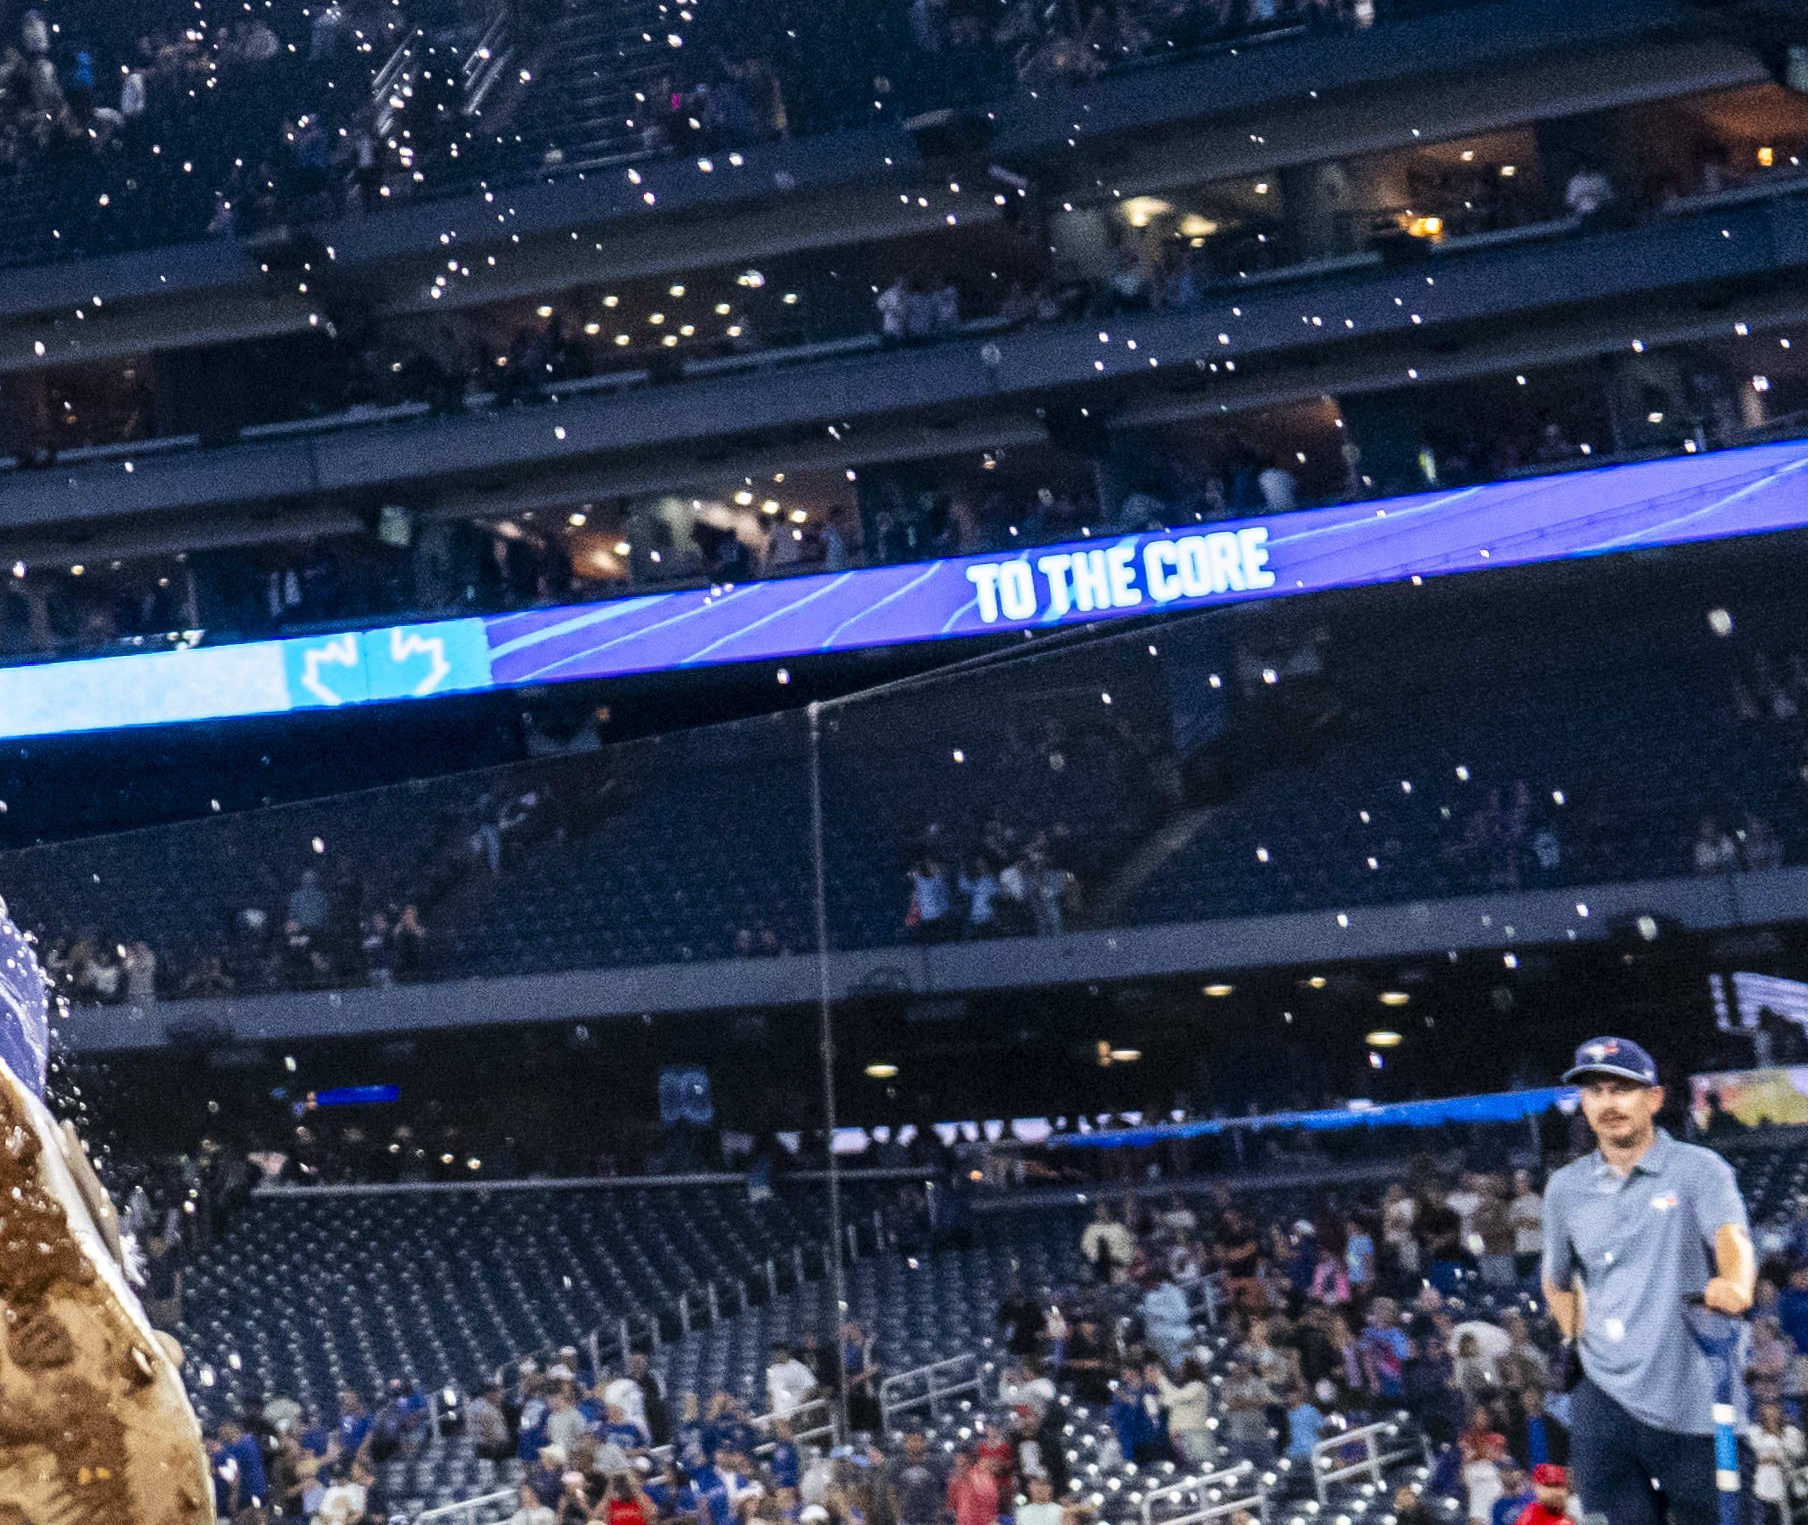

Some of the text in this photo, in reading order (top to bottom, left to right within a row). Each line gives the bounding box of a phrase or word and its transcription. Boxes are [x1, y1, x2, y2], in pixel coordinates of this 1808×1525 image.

[966, 527, 1276, 623] TO THE CORE
